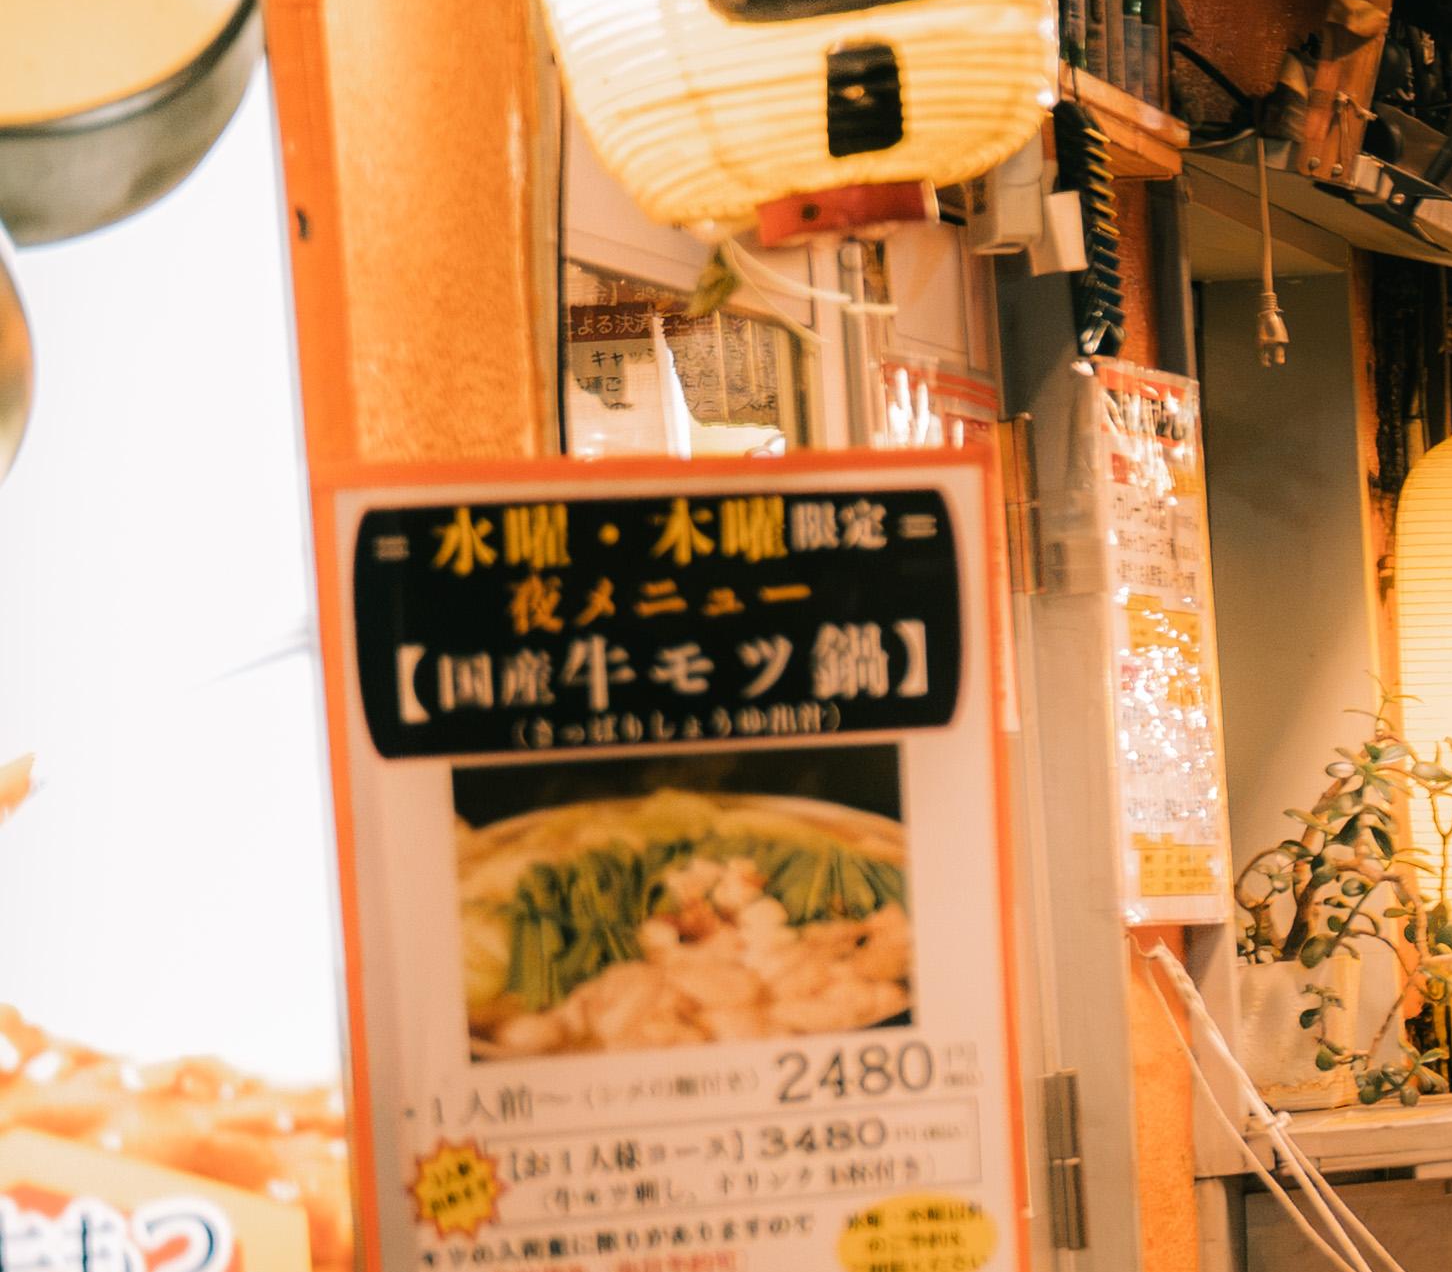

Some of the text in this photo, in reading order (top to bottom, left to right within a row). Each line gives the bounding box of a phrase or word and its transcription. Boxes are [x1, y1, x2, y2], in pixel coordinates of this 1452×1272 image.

[508, 574, 812, 634] 夜メニュー
[775, 1041, 934, 1105] 2480
[758, 1119, 888, 1161] 3480
